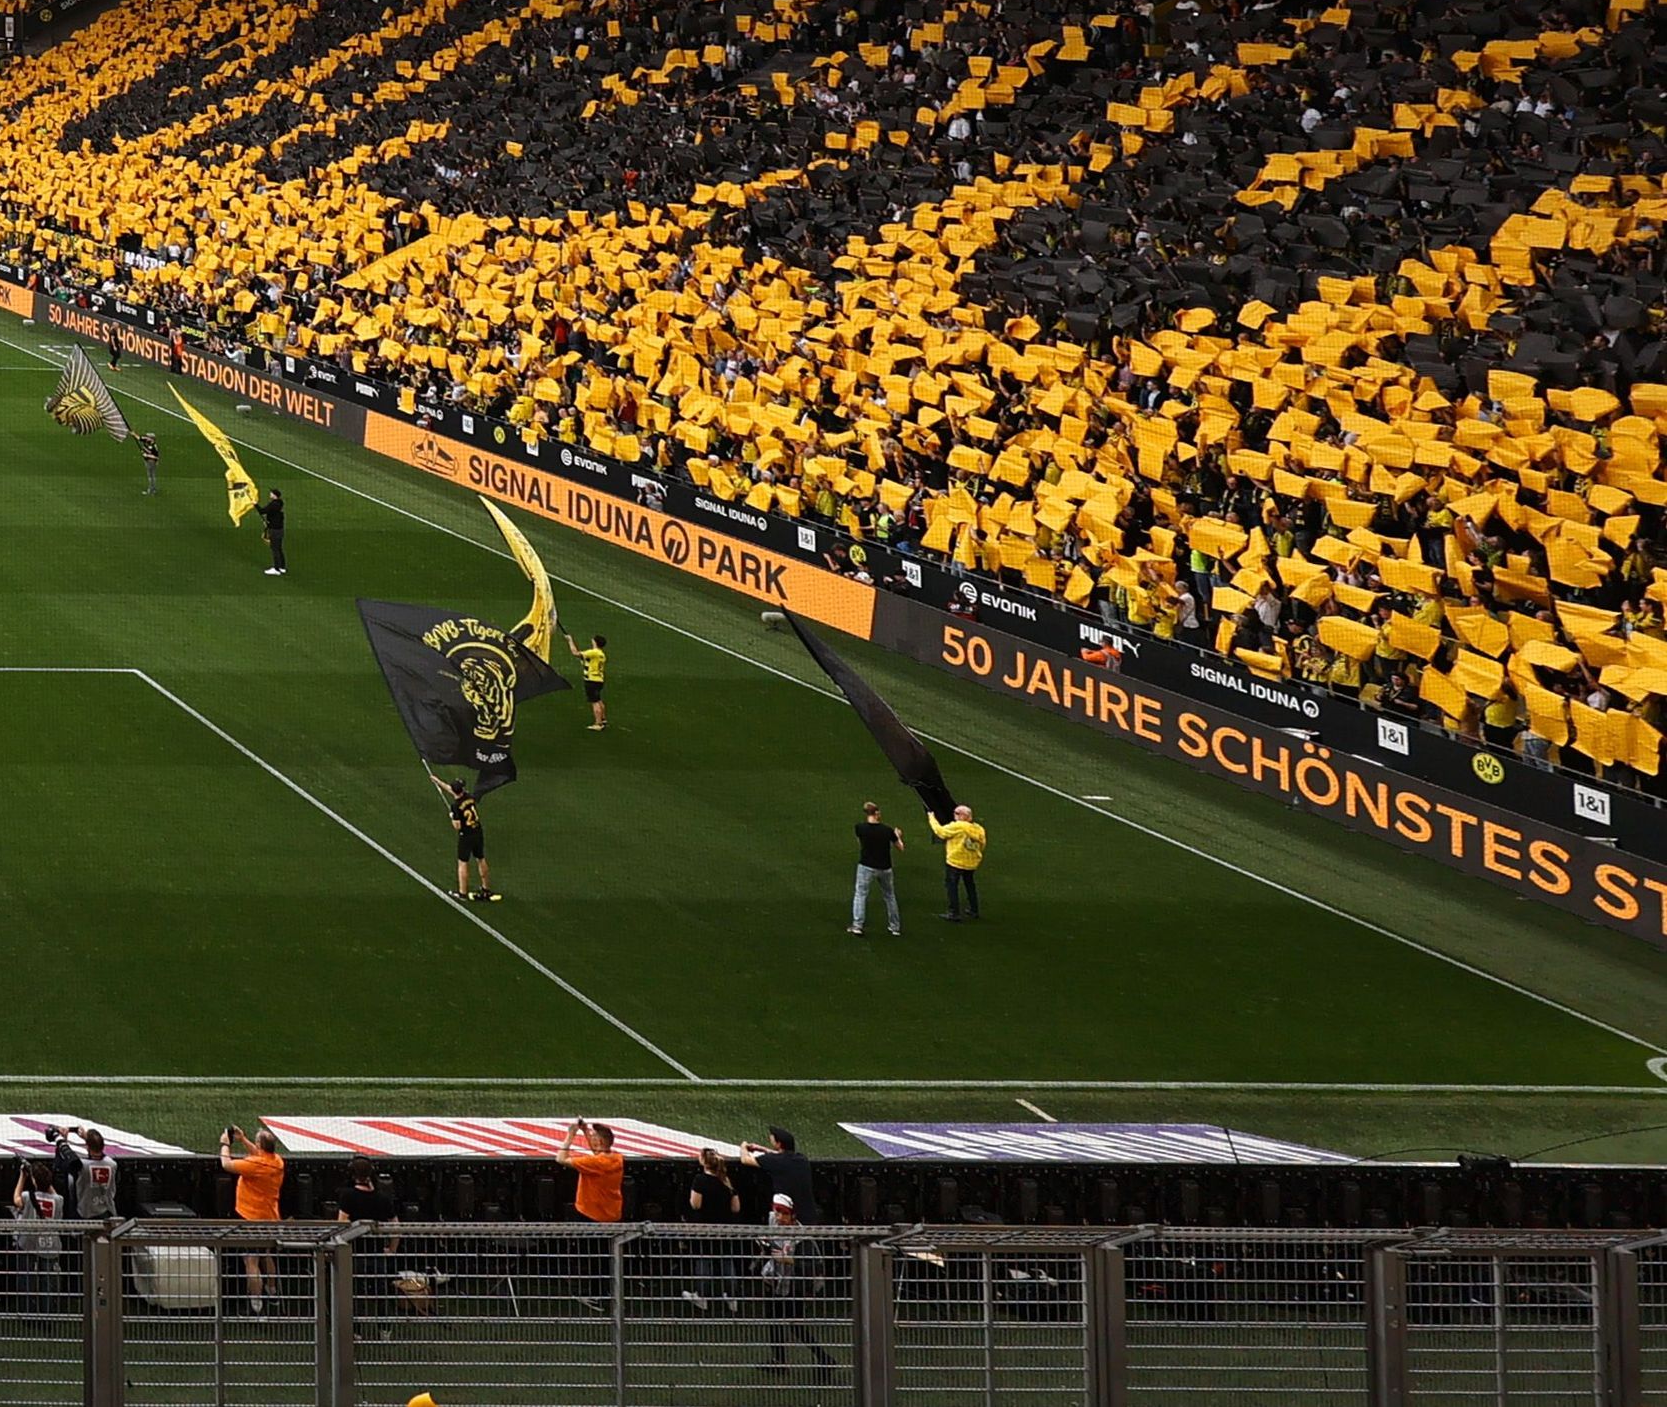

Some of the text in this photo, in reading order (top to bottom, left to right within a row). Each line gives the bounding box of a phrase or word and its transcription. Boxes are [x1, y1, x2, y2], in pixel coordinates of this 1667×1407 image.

[48, 303, 63, 324] 50
[63, 309, 100, 338] JAHRE
[181, 349, 245, 391] STADION
[249, 375, 282, 408] DER
[284, 388, 335, 428] WELT
[574, 456, 608, 476] EVONIK
[694, 497, 757, 528] SIGNAL IDUNA
[469, 455, 789, 600] SIGNAL IDUNA PARK
[799, 531, 814, 546] 1&1
[981, 594, 1037, 621] EVONIK
[1190, 662, 1301, 712] SIGNAL IDUNA
[1379, 724, 1406, 748] 1&1
[941, 625, 994, 676] 50
[1003, 651, 1164, 743] JAHRE
[1177, 713, 1572, 895] SCHÖNSTES
[463, 804, 480, 827] 21
[1576, 792, 1607, 816] 1&1
